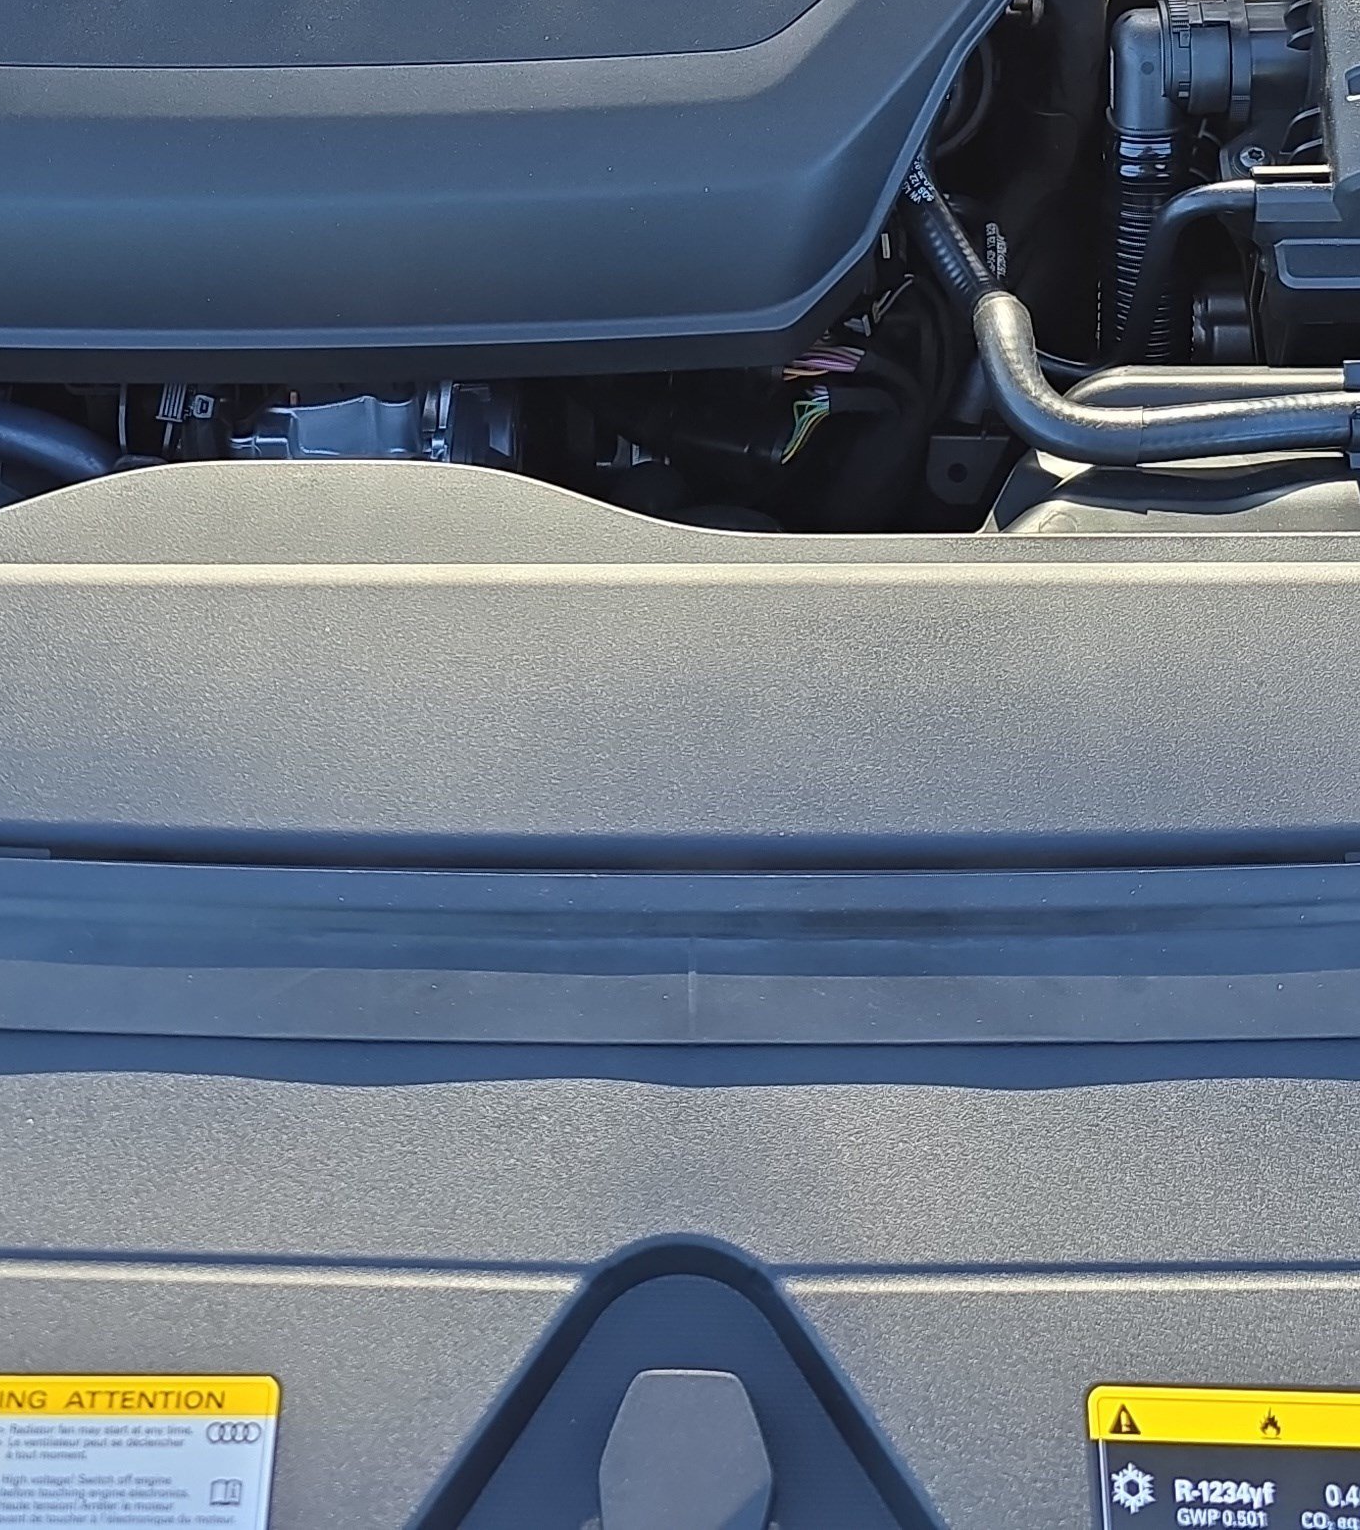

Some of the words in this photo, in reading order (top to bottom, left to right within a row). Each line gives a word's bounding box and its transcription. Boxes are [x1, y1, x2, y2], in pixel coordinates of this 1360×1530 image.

[64, 1389, 227, 1410] ATTENTION
[1174, 1478, 1276, 1509] R-1234yf
[1176, 1507, 1221, 1527] GWP
